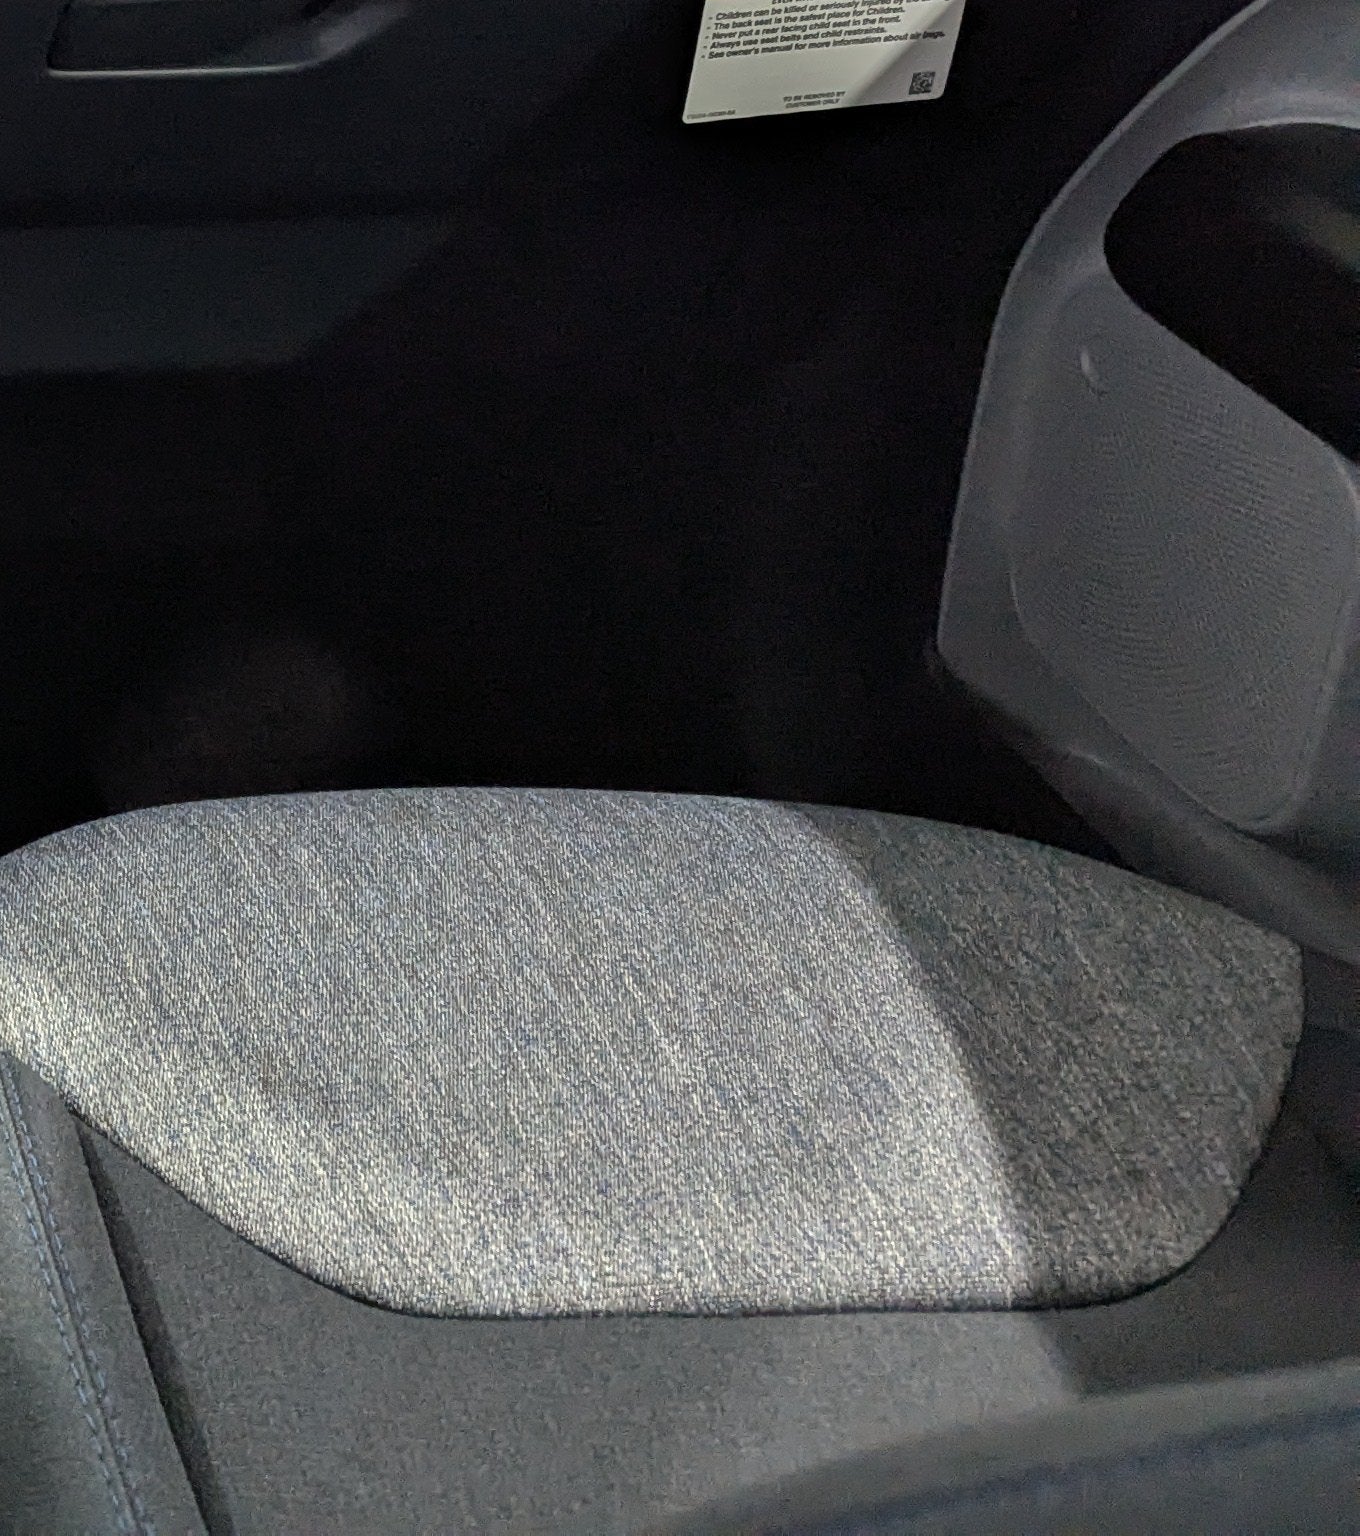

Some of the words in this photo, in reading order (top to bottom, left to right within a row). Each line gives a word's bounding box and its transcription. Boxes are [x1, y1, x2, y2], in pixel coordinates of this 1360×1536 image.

[716, 10, 752, 21] Children
[783, 4, 807, 13] killed
[820, 0, 859, 11] seriously
[714, 22, 730, 30] The
[783, 15, 798, 23] the
